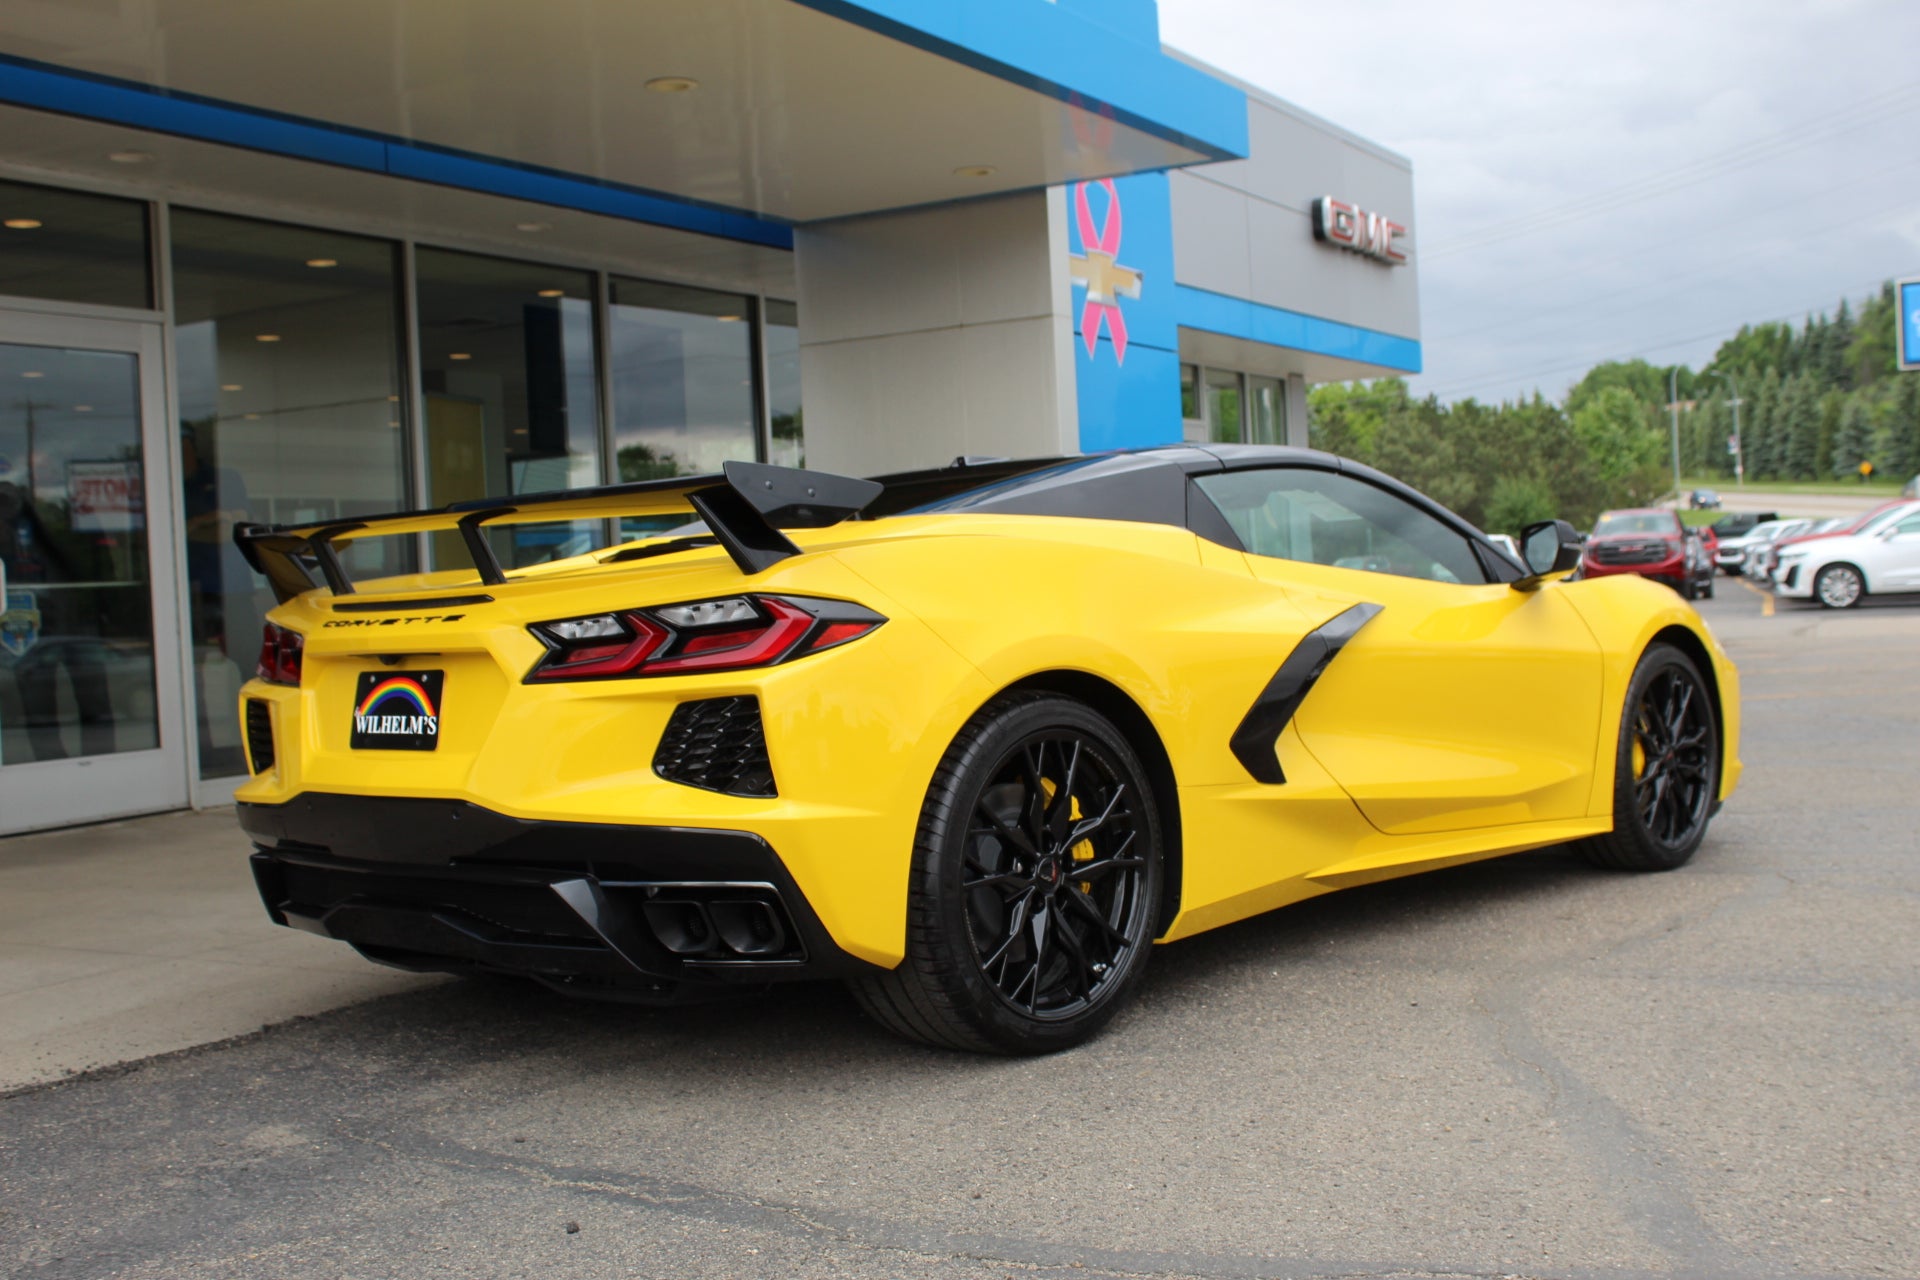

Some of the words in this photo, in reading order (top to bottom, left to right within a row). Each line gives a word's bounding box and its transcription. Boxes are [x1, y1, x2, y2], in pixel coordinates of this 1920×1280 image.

[1315, 194, 1408, 267] GMC
[322, 613, 467, 629] CORVETTE
[355, 713, 437, 735] WILHELM'S
